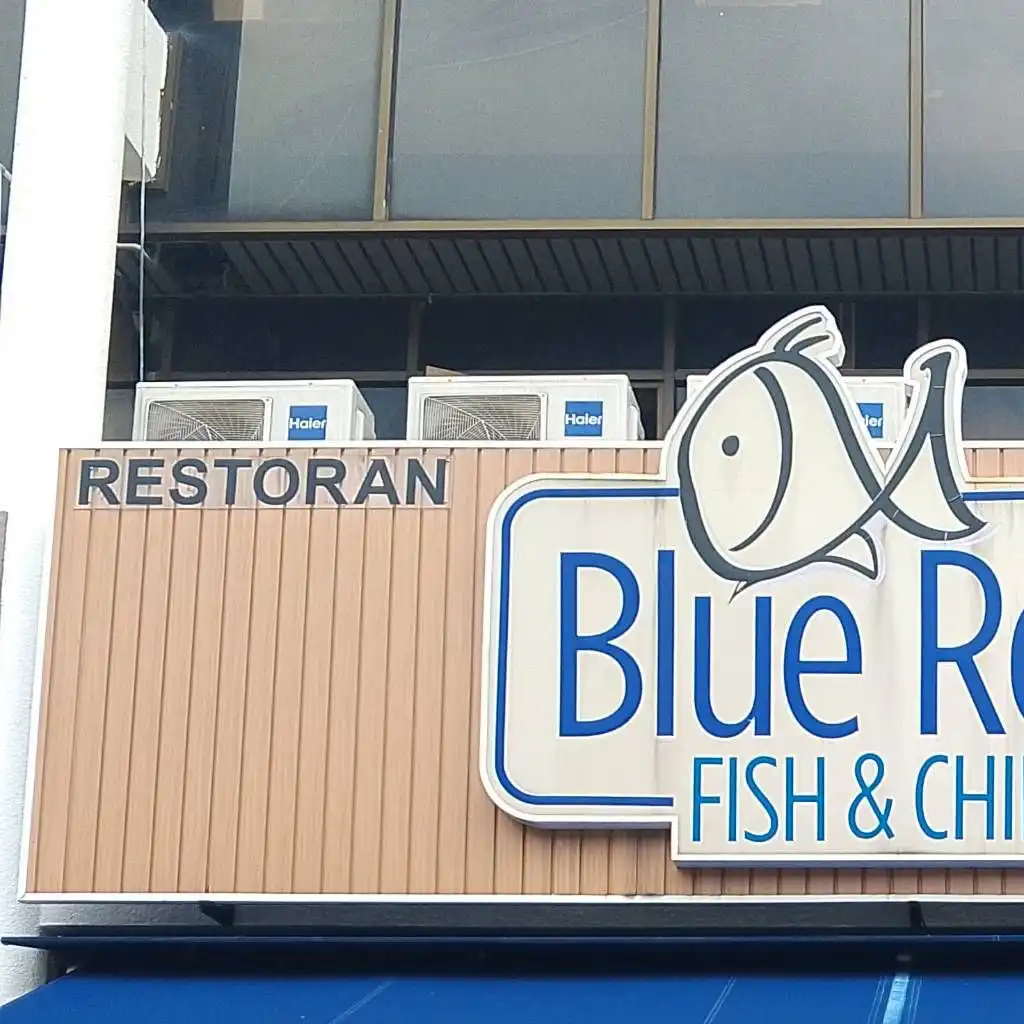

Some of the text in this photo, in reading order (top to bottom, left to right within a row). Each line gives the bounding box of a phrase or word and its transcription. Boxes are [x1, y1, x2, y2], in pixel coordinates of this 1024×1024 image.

[289, 417, 327, 429] Haier
[565, 413, 603, 425] Haier
[864, 414, 883, 427] ier
[77, 458, 447, 505] RESTORAN
[557, 550, 862, 739] Blue
[691, 755, 826, 843] FISH
[847, 752, 895, 841] &
